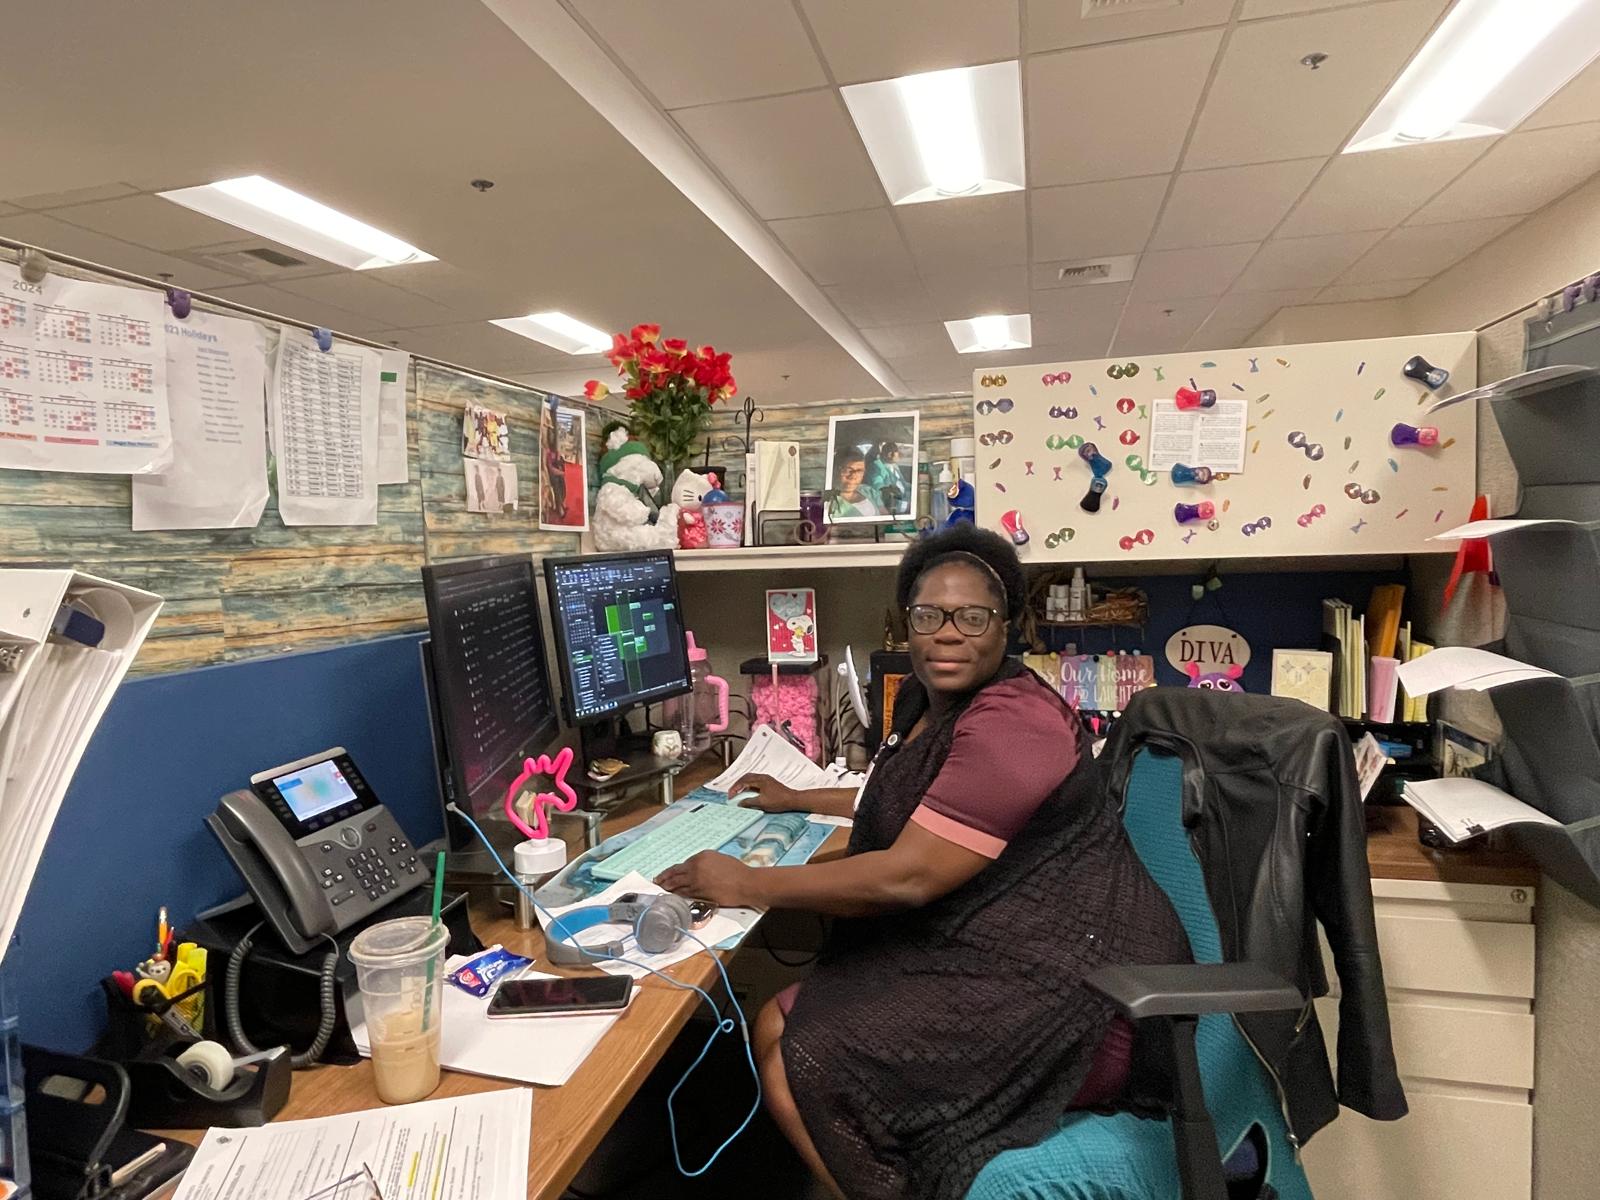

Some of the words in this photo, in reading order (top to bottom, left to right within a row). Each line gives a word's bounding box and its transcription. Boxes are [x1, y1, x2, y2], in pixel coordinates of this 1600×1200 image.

[12, 280, 43, 296] 2024
[1179, 639, 1237, 665] DIVA
[1061, 661, 1097, 682] Our
